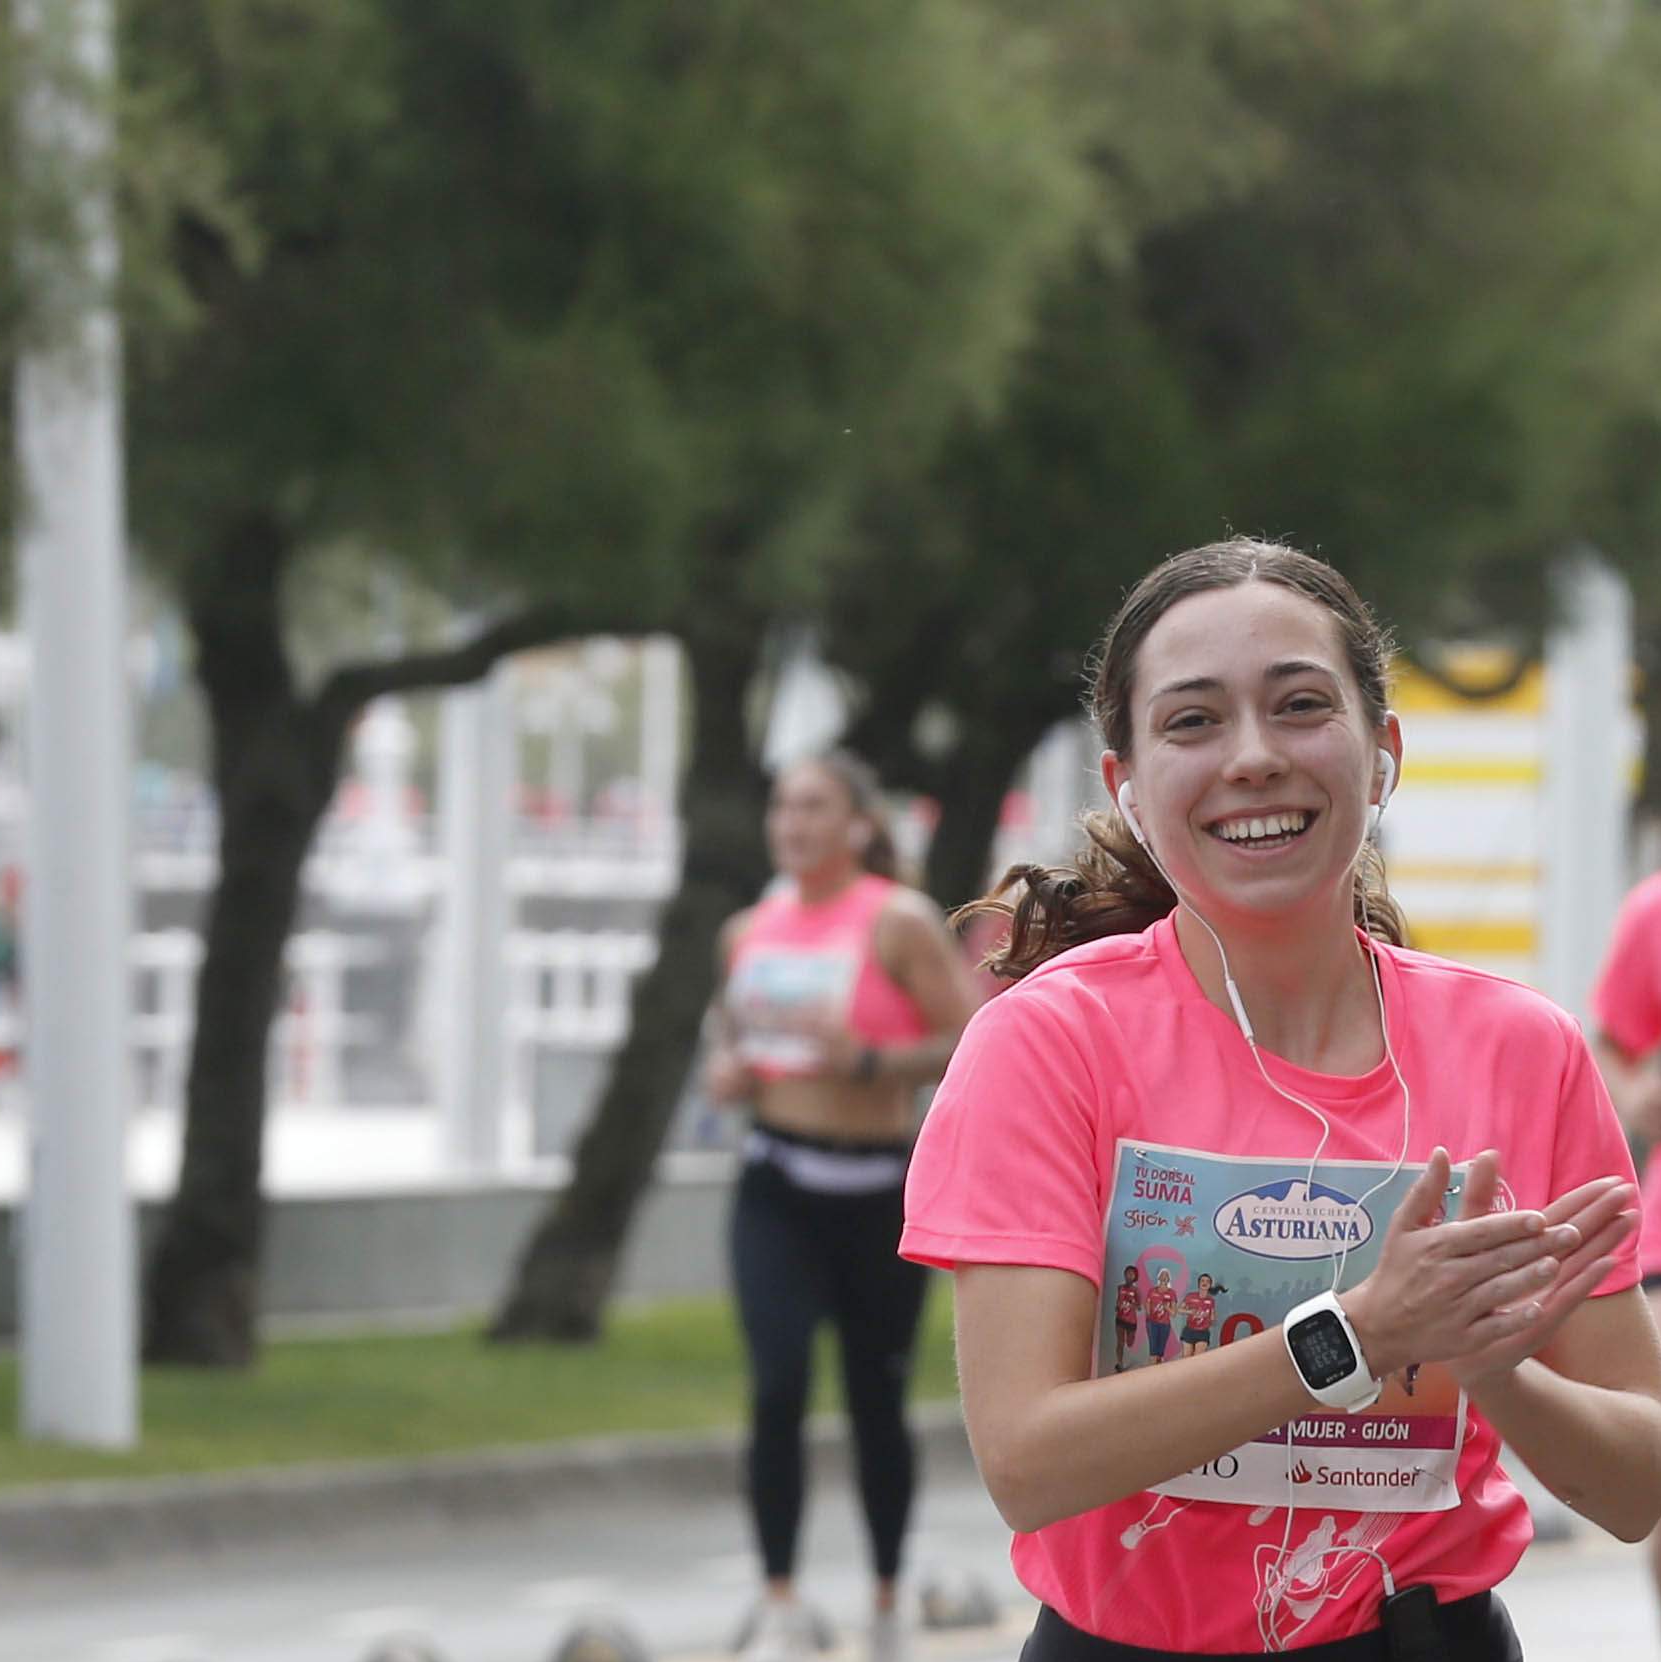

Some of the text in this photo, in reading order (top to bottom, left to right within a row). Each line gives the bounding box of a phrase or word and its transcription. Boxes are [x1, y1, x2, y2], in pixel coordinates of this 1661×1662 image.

[1135, 1167, 1195, 1185] TU DORSAL
[1133, 1180, 1192, 1205] SUMA
[1254, 1206, 1302, 1216] CENTRAL
[1225, 1207, 1362, 1241] ASTURIANA
[1291, 1421, 1345, 1438] MUJER
[1362, 1418, 1409, 1440] GIJÓN
[1316, 1466, 1419, 1487] Santander
